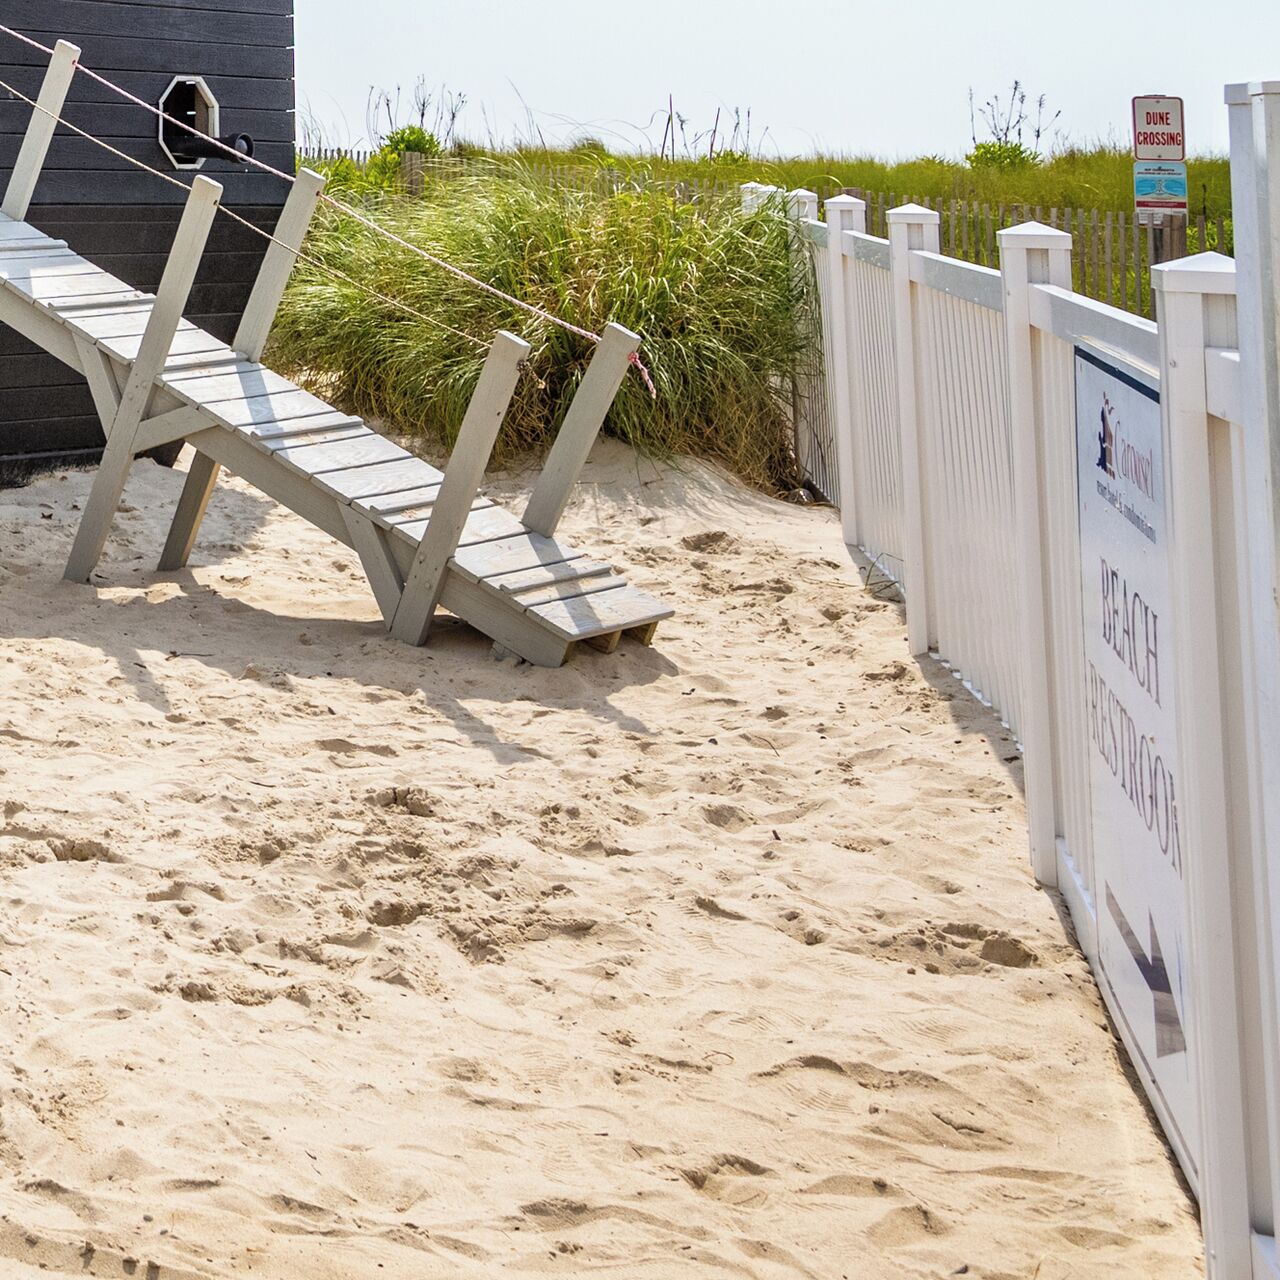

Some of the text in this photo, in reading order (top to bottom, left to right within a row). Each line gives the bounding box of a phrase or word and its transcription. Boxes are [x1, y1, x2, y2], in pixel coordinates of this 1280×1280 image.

[1137, 131, 1182, 146] CROSSING
[1145, 111, 1171, 126] DUNE
[1115, 419, 1155, 503] Carousel
[1100, 556, 1161, 709] BEACH
